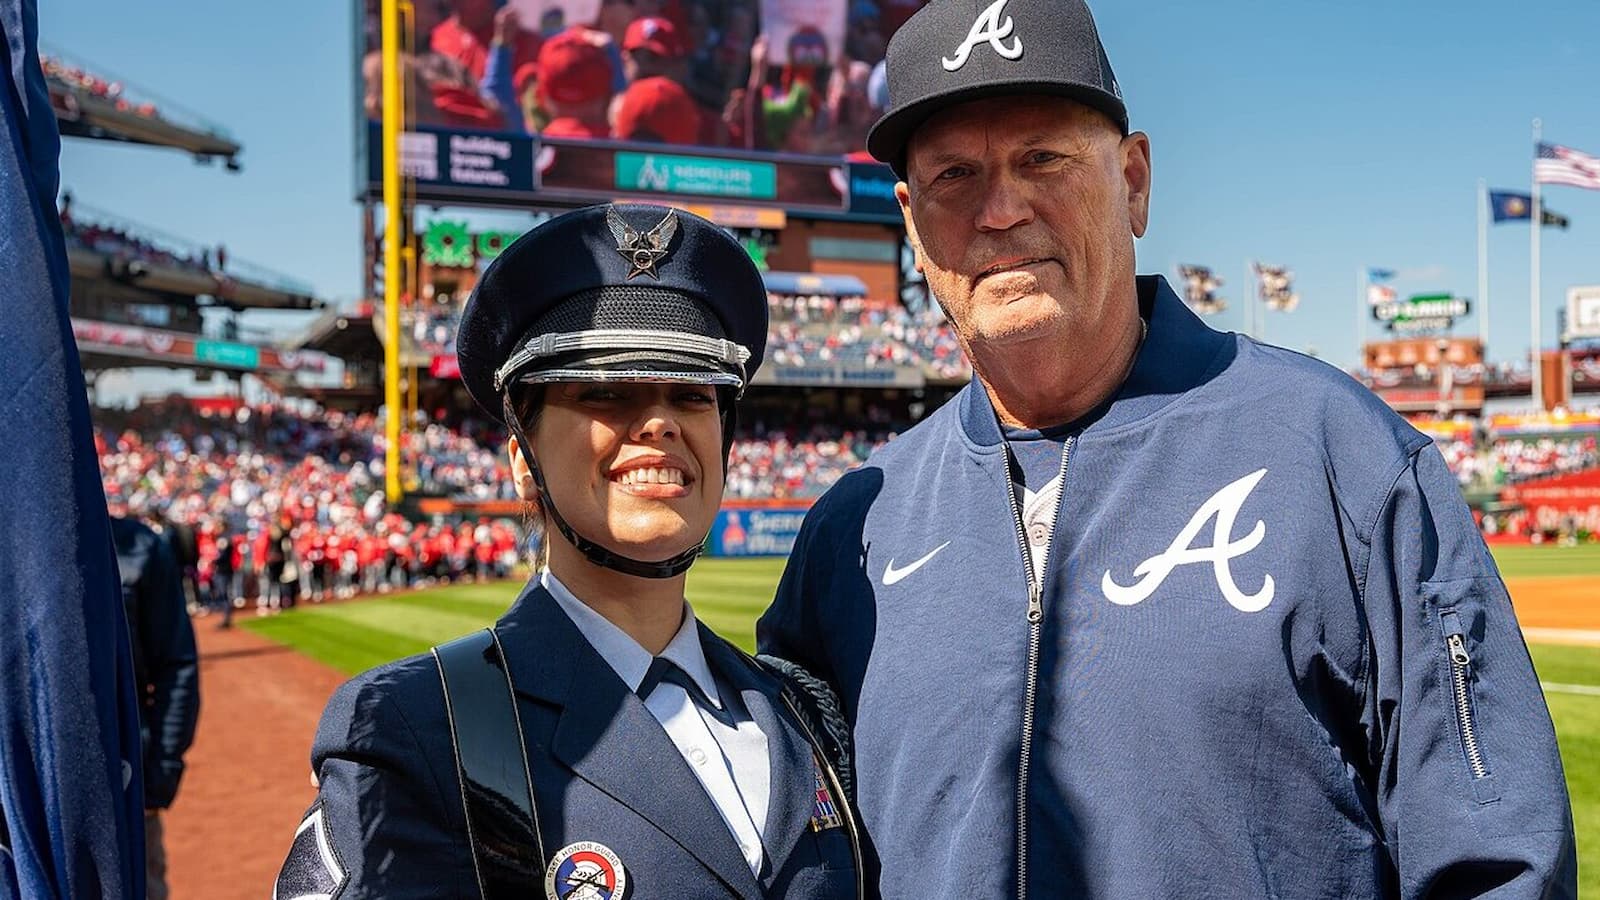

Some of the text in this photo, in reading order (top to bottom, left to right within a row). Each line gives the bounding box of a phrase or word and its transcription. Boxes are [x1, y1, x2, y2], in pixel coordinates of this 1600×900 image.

[942, 0, 1024, 71] A
[1102, 468, 1275, 613] A
[561, 843, 592, 858] HONOR
[594, 844, 619, 867] GUARD
